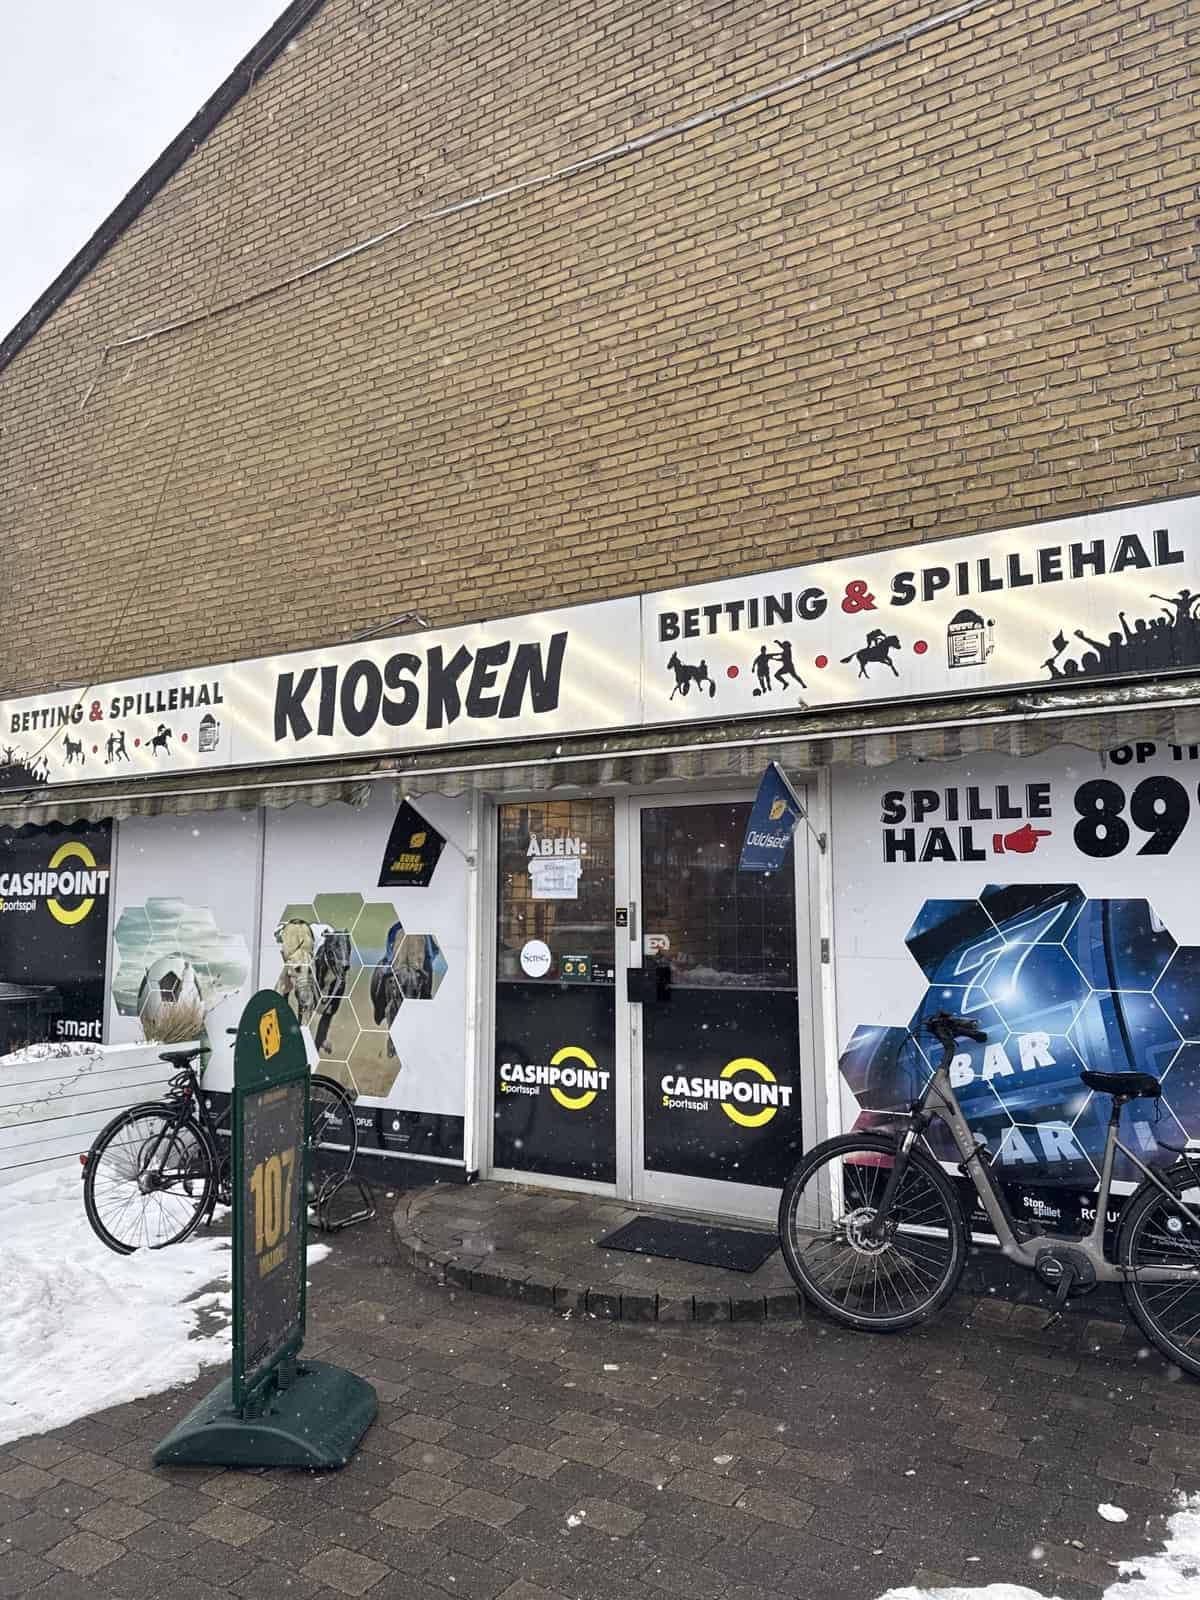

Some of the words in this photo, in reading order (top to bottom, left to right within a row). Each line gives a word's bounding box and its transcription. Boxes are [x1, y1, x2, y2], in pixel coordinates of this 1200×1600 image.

[657, 588, 828, 642] BETTING
[842, 579, 878, 615] &
[889, 529, 1185, 606] SPILLEHAL
[274, 631, 569, 743] KIOSKEN
[10, 703, 84, 733] BETTING
[89, 700, 104, 722] &
[109, 682, 224, 719] SPILLEHAL
[1109, 742, 1156, 765] OP
[880, 783, 1052, 825] SPILLE
[1073, 775, 1200, 858] 89
[526, 833, 587, 857] ÅBEN:
[881, 825, 987, 863] HAL
[0, 870, 109, 896] CASHPOINT
[56, 1019, 102, 1039] smart
[949, 1032, 1057, 1088] BAR
[500, 1063, 611, 1092] CASHPOINT
[501, 1081, 540, 1096] Sportsspil
[661, 1075, 793, 1107] CASHPOINT
[662, 1095, 709, 1112] Sportsspil
[249, 1146, 296, 1256] 107
